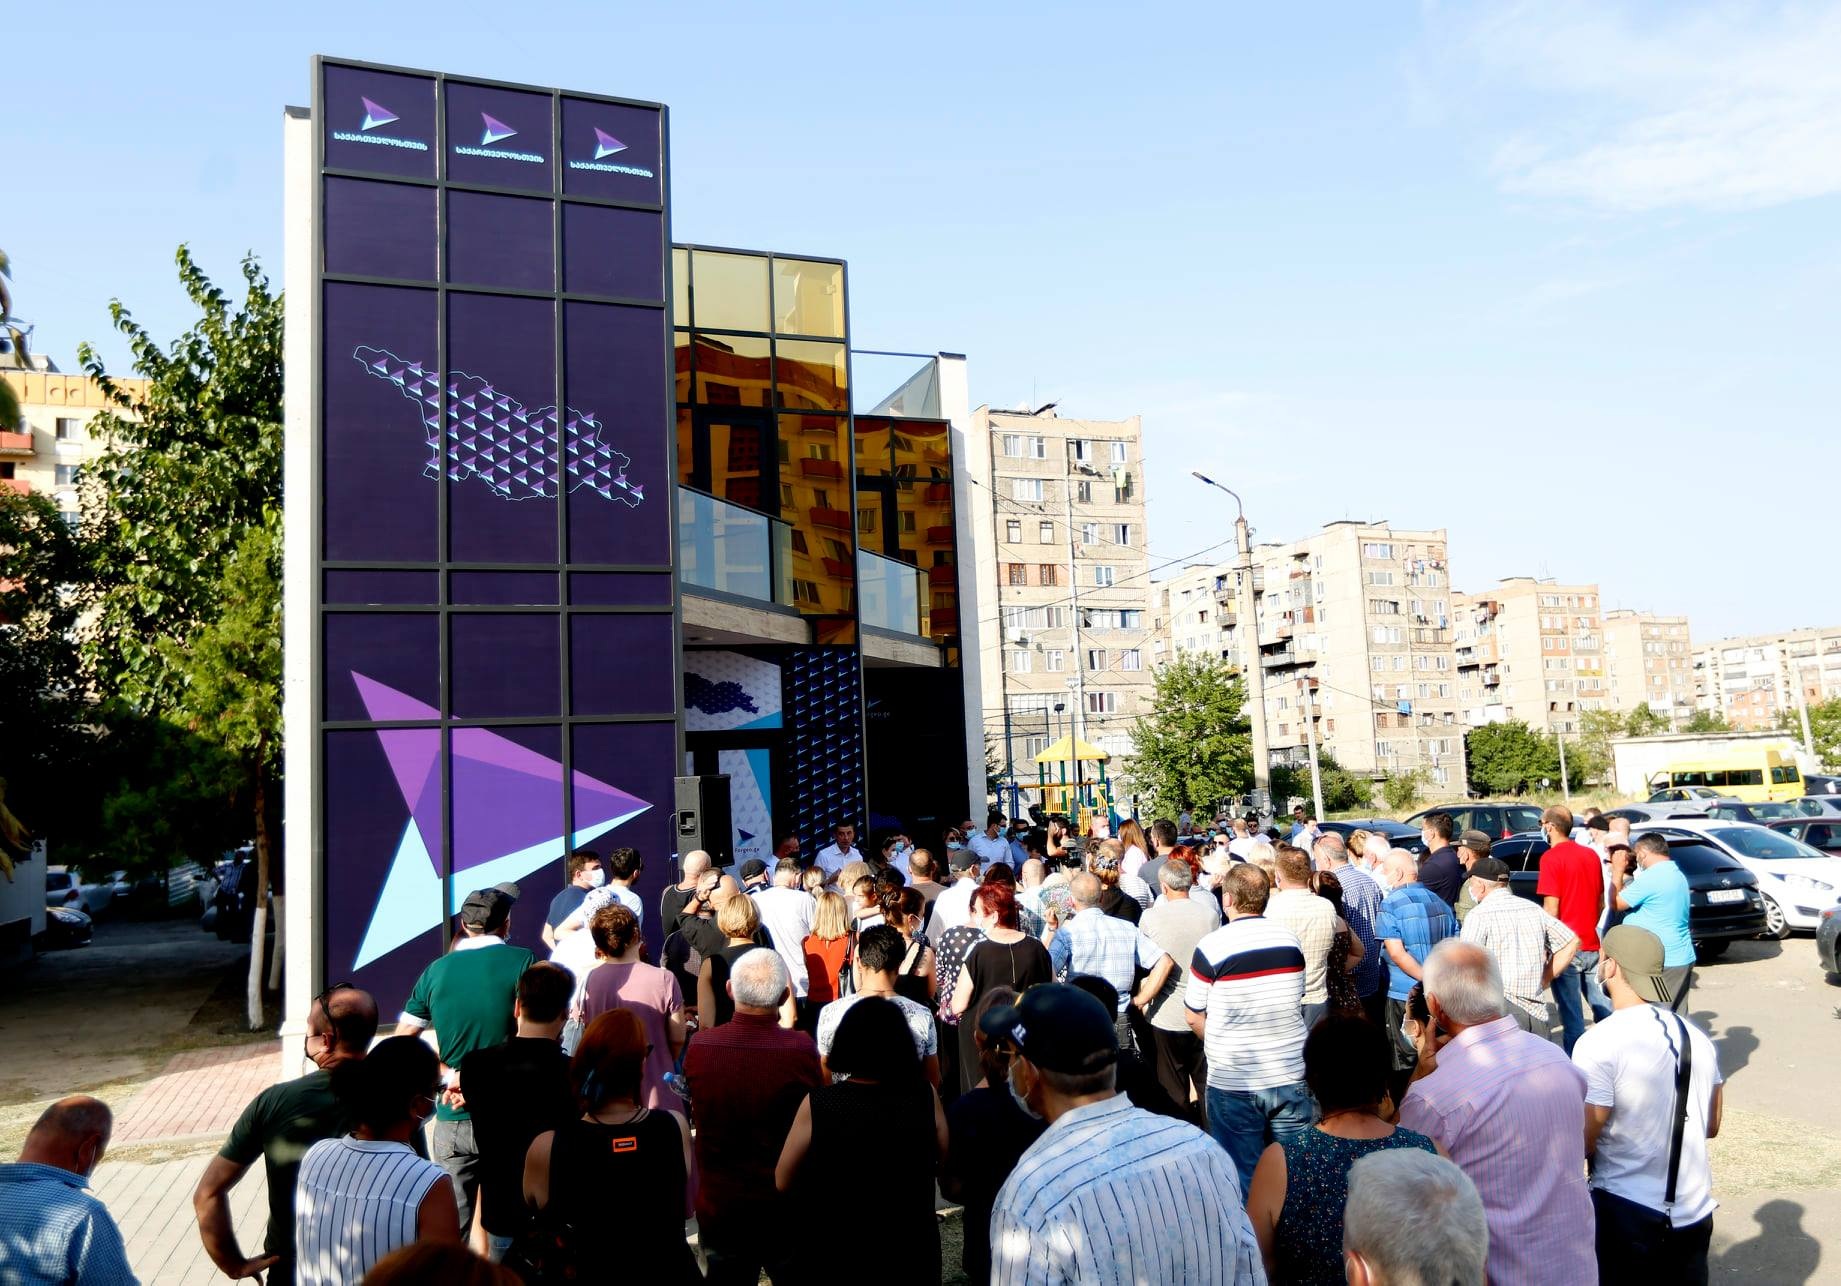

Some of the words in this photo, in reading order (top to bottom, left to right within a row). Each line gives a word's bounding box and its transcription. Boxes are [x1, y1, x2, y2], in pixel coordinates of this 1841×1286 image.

[333, 132, 428, 151] საქართველოსთვის
[455, 146, 545, 163] საქართველოსთვის
[570, 161, 653, 178] საქართველოსთვის
